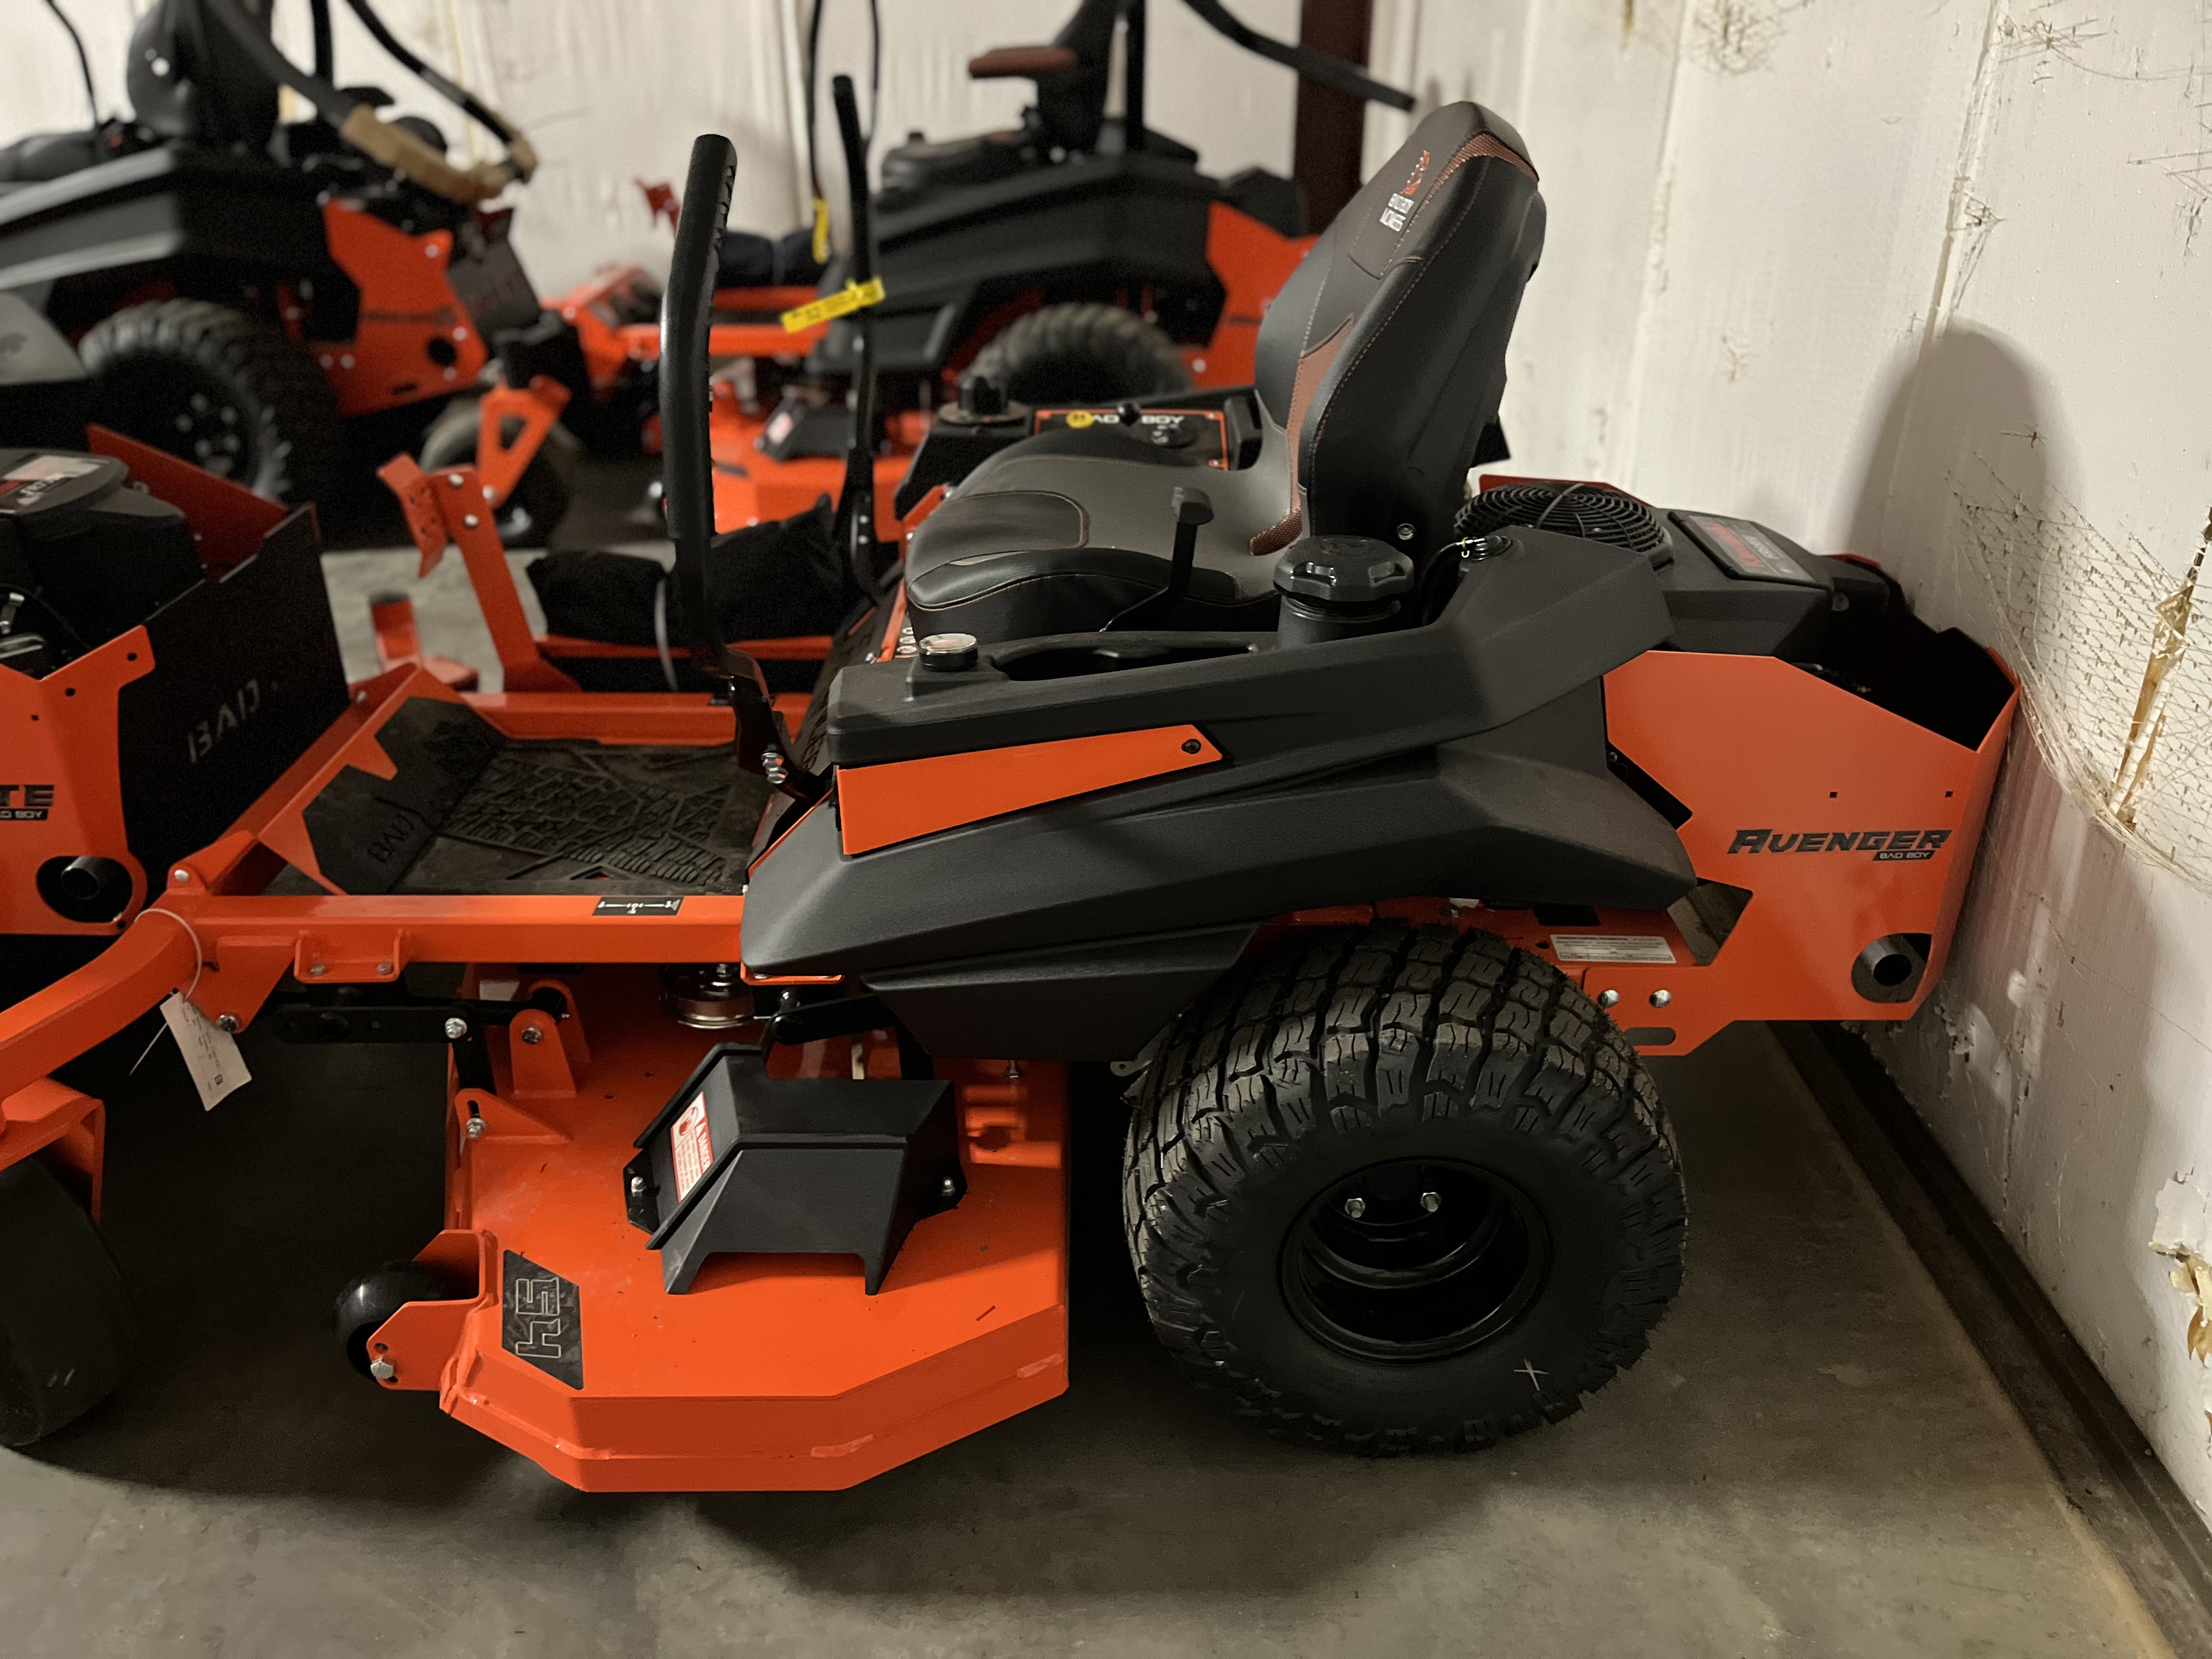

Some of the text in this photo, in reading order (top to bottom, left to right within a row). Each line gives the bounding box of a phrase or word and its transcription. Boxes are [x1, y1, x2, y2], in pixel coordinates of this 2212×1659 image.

[1141, 414, 1184, 425] BOY
[187, 678, 260, 763] BAD
[1727, 829, 1953, 854] AVENGER
[697, 1131, 712, 1173] DANGER
[515, 1276, 562, 1359] 54
